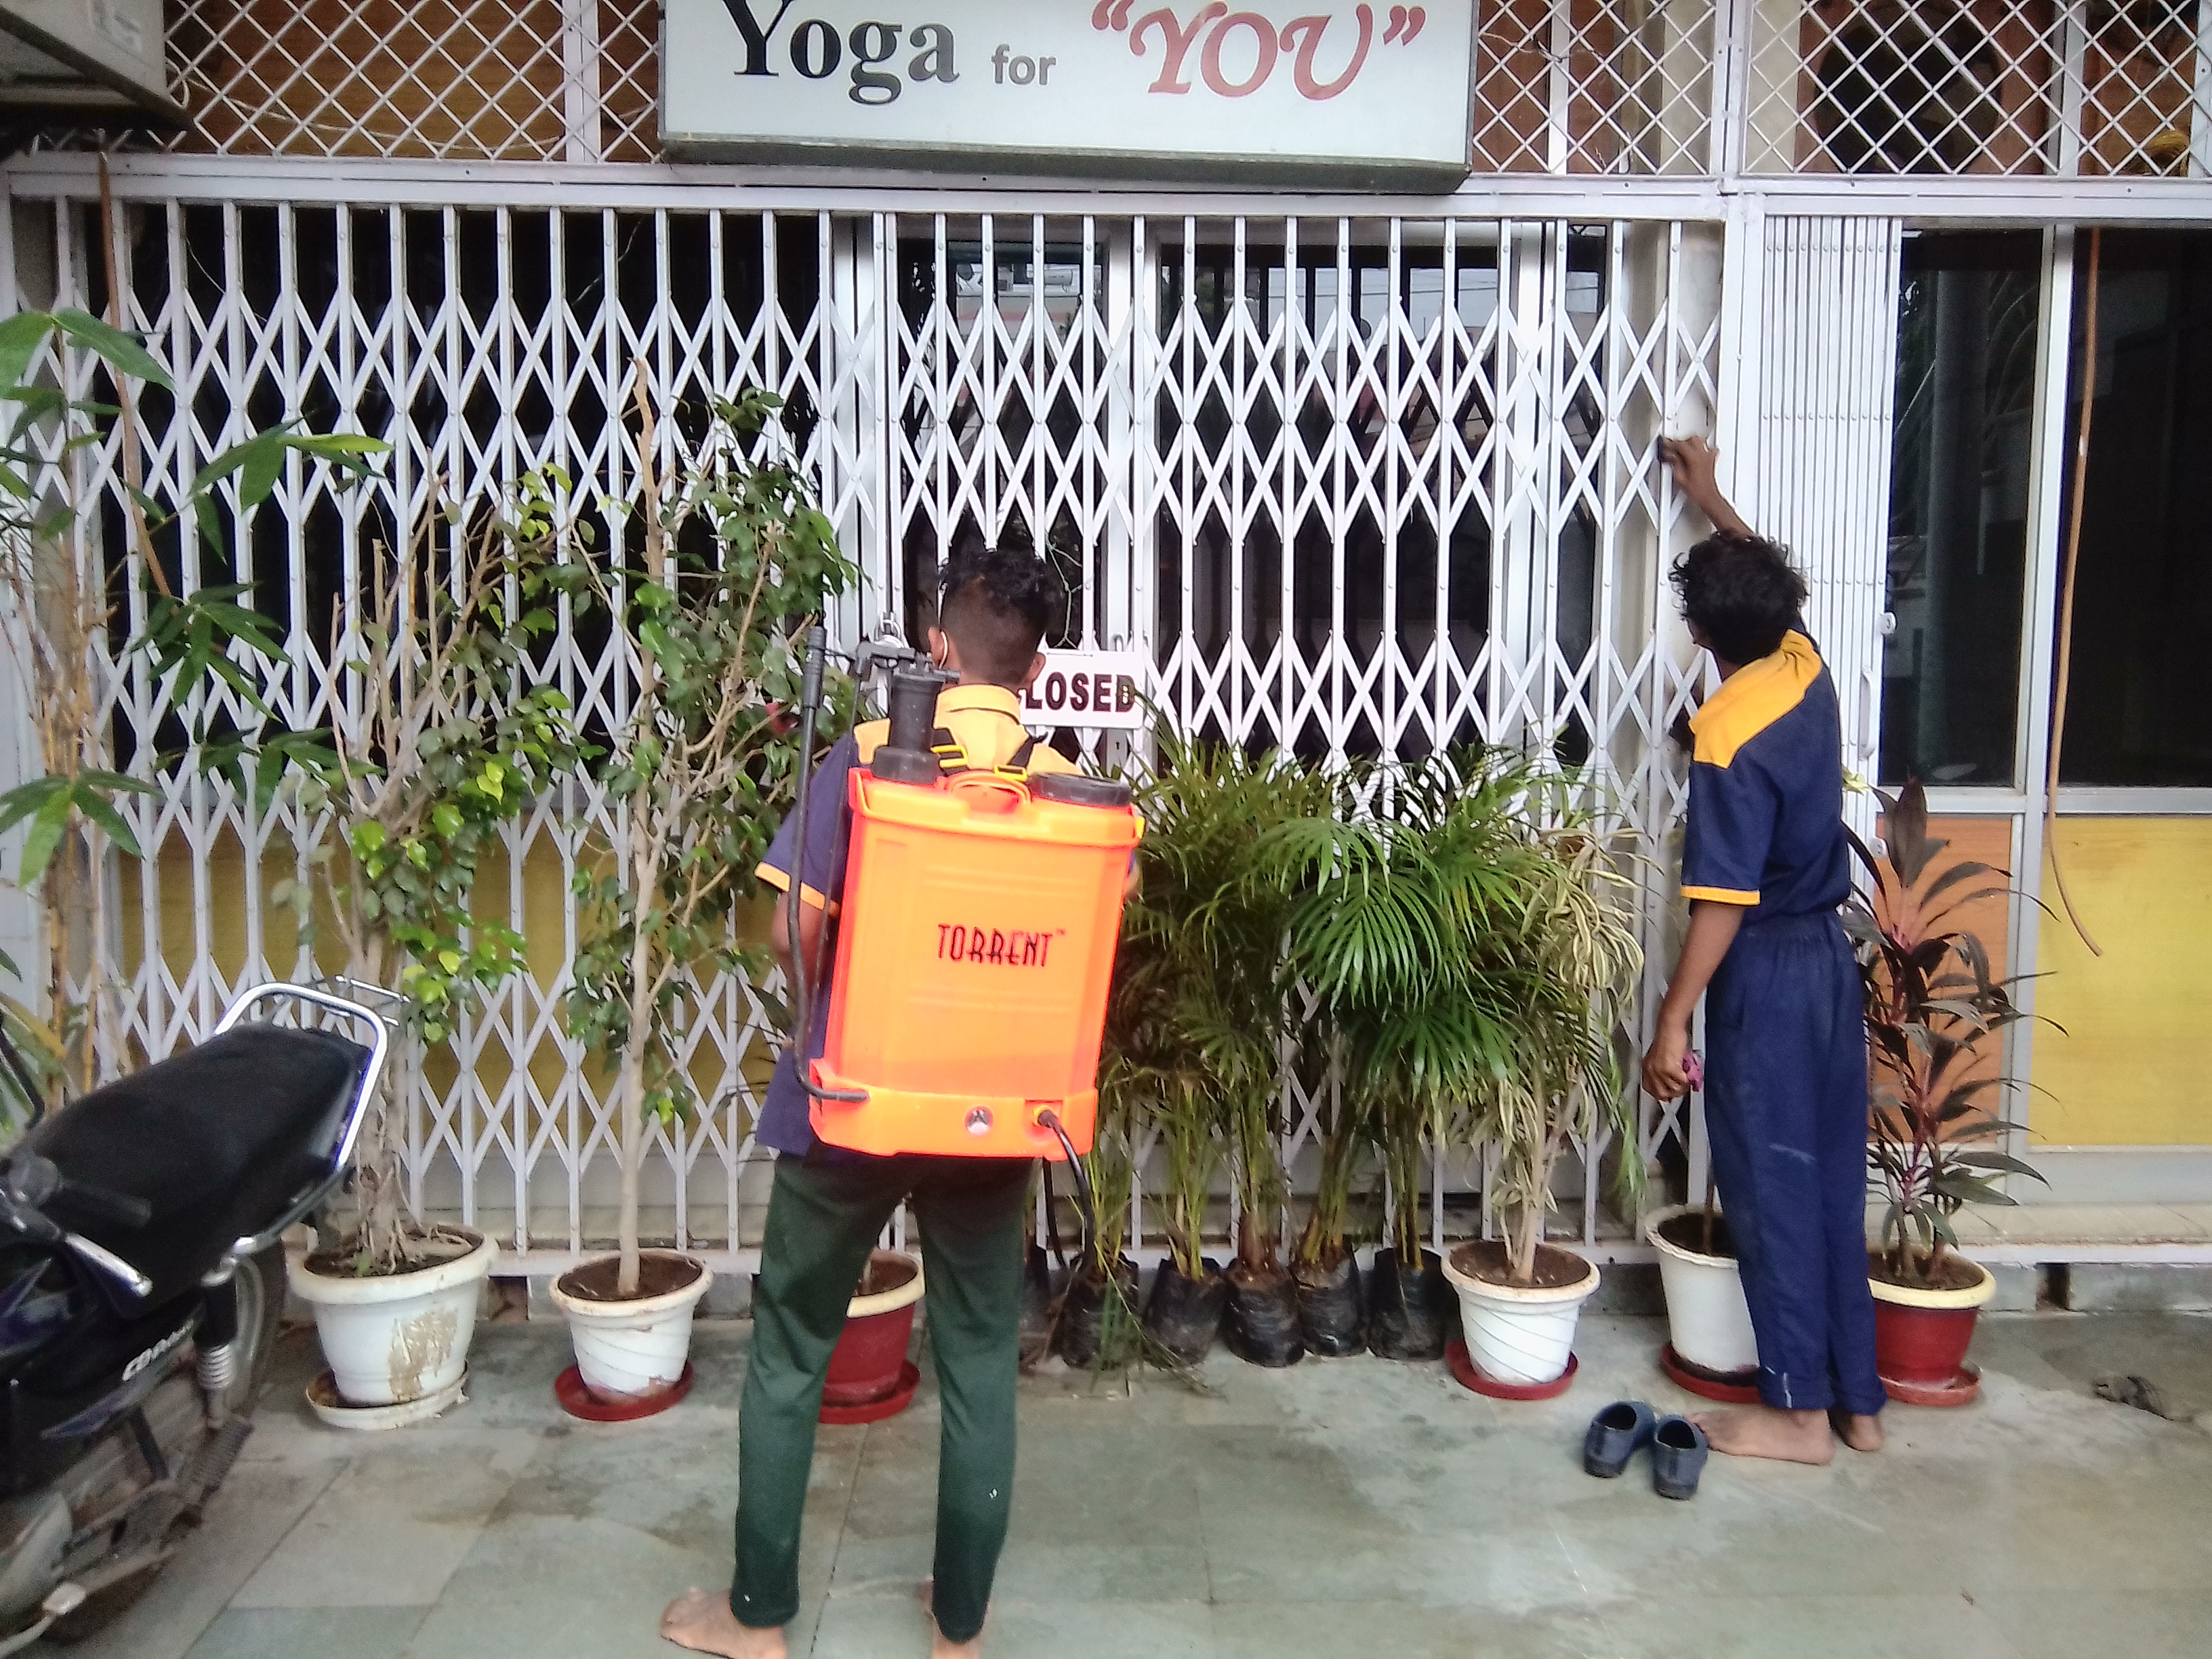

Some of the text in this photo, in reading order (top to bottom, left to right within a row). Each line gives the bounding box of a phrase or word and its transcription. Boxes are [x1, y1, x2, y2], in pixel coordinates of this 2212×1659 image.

[722, 0, 960, 104] Yoga
[991, 44, 1056, 85] for
[1019, 671, 1135, 712] LOSED
[938, 923, 1053, 968] TORRENT
